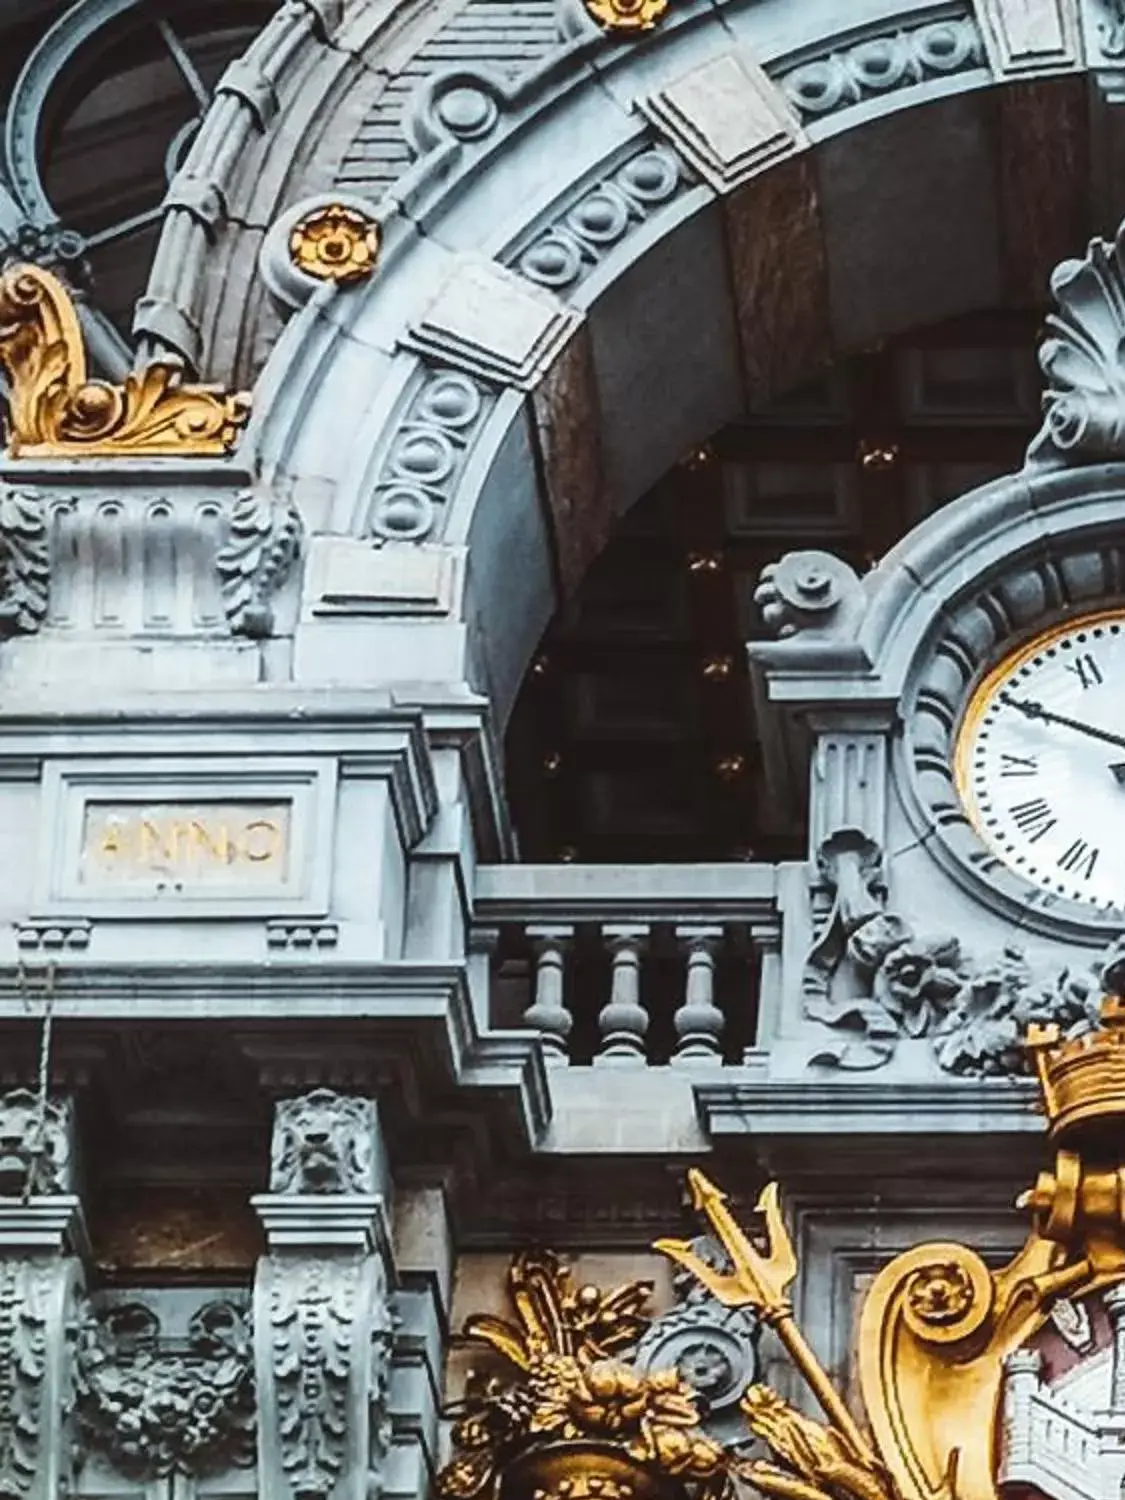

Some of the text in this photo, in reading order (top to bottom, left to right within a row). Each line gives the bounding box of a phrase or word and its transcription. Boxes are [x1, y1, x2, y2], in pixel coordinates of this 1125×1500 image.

[1064, 653, 1103, 689] XI
[1008, 798, 1057, 843] VIII
[1057, 838, 1099, 880] VII
